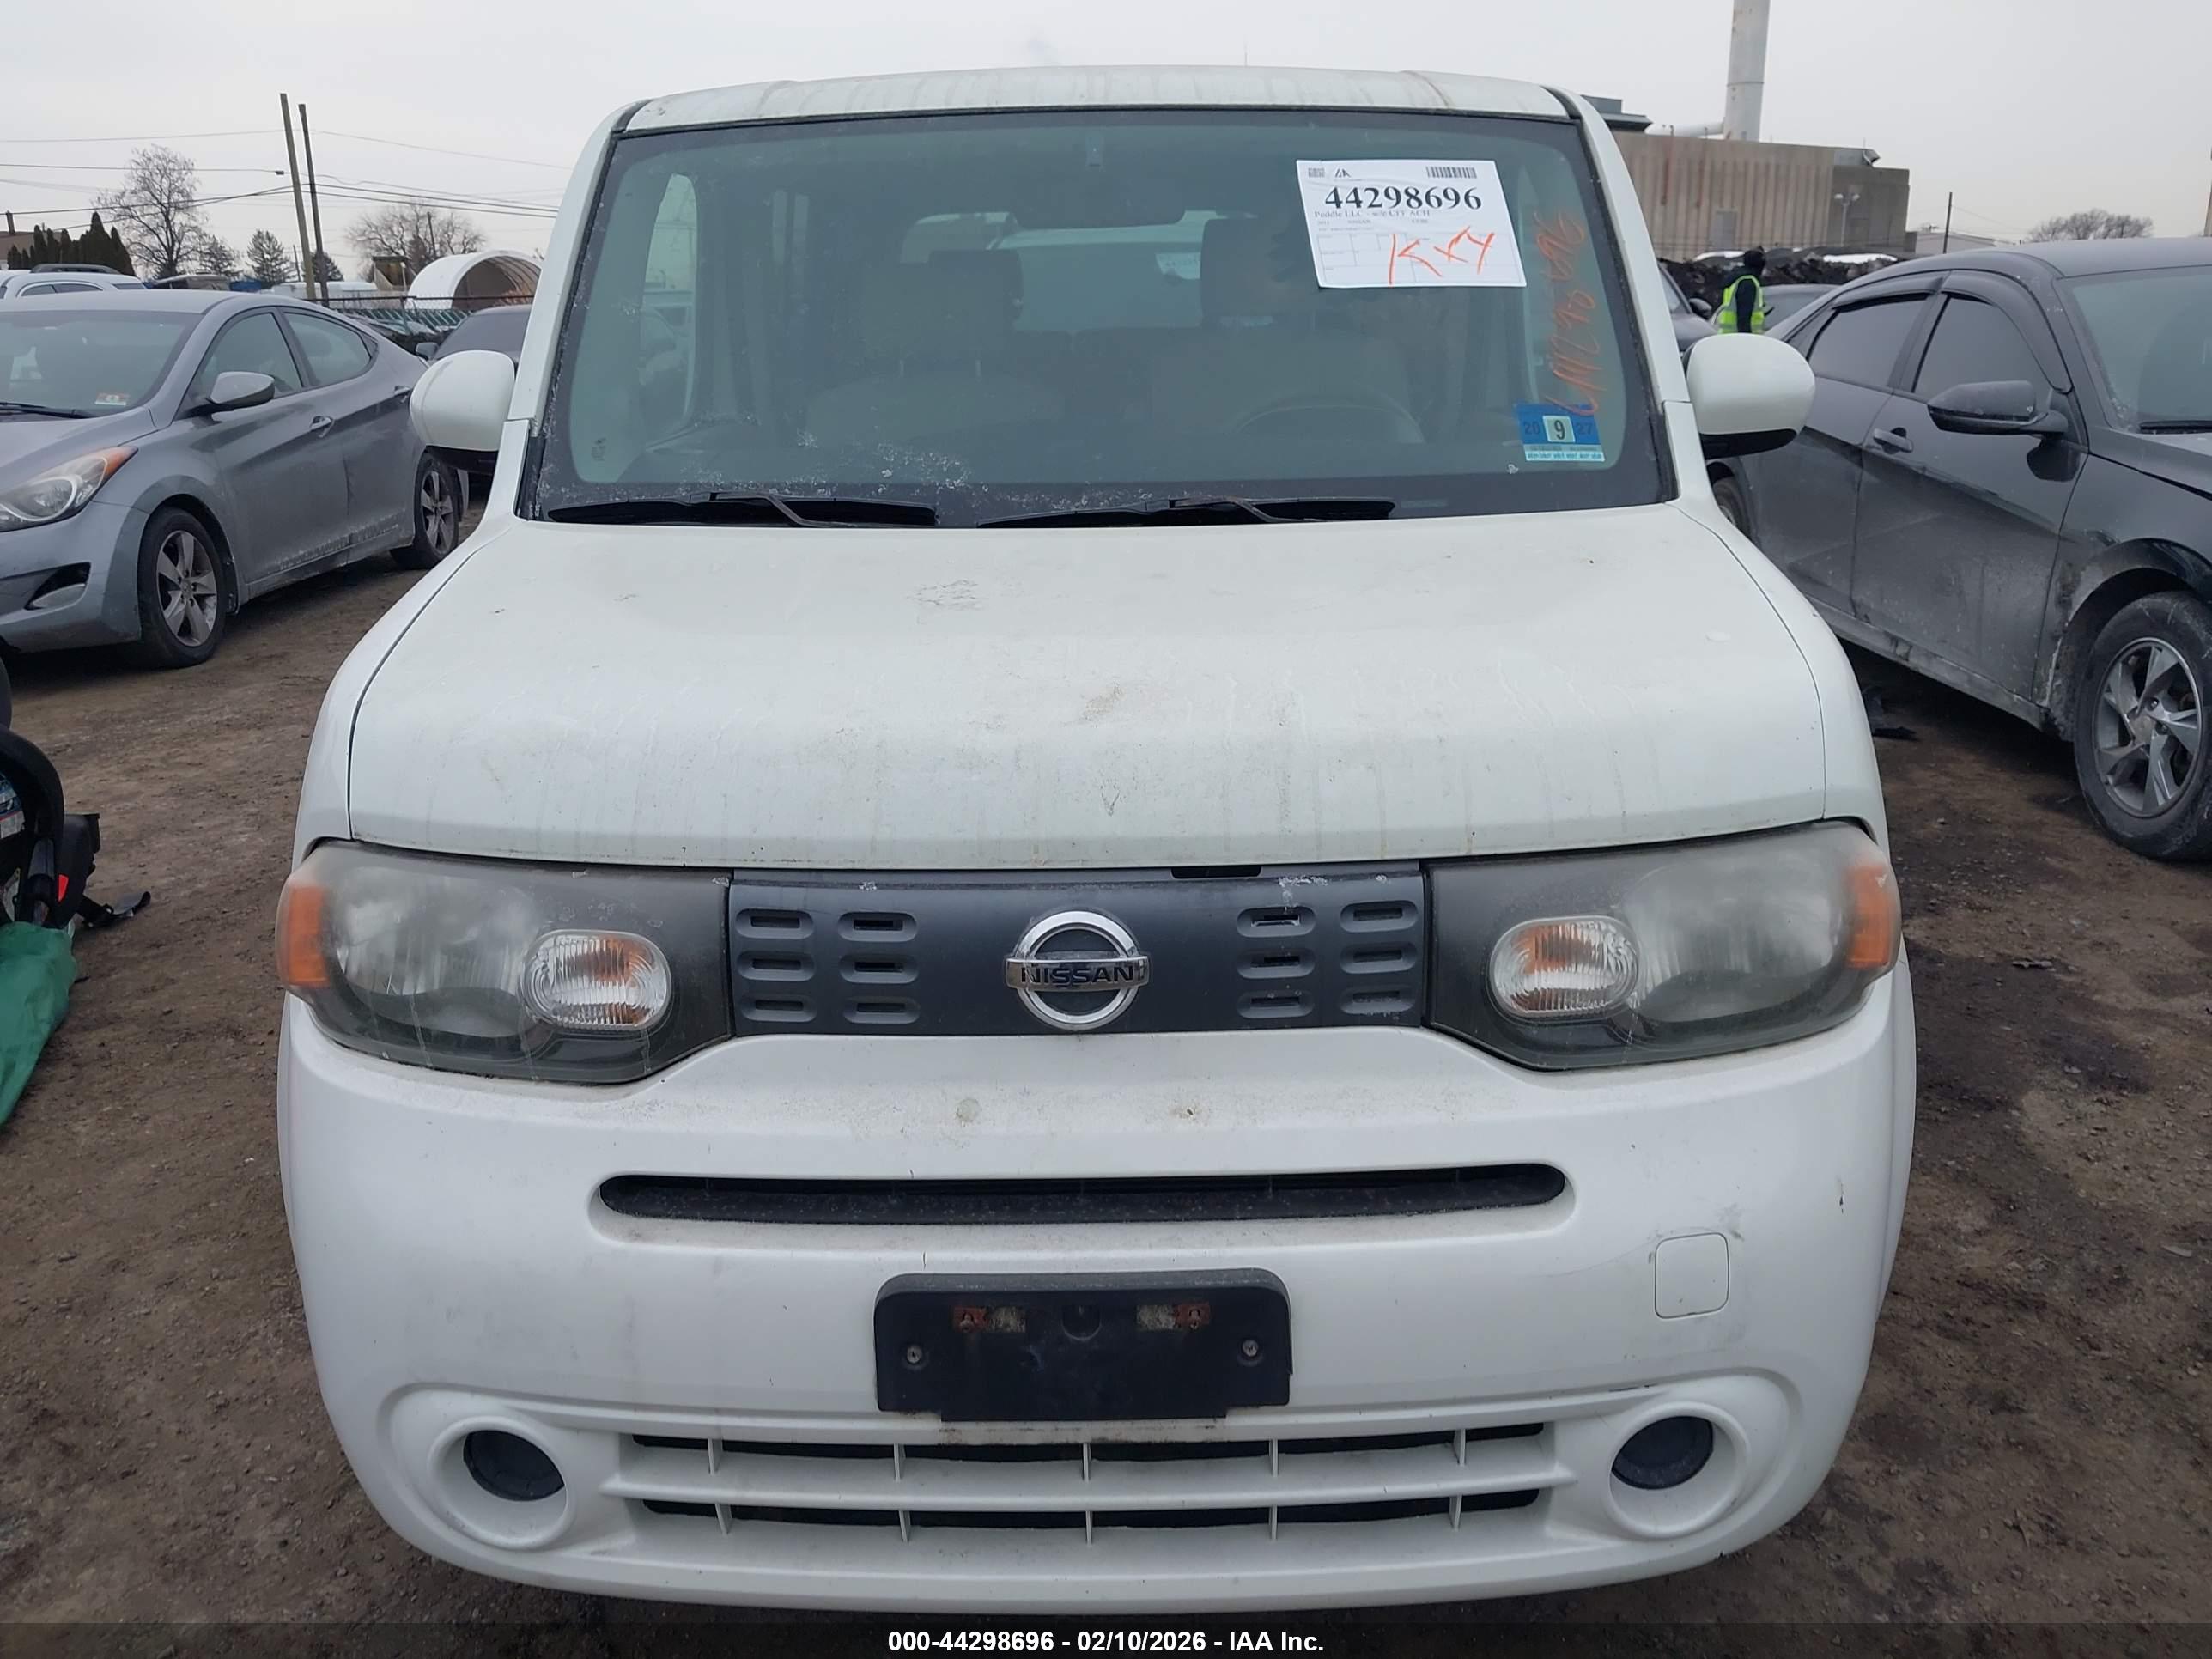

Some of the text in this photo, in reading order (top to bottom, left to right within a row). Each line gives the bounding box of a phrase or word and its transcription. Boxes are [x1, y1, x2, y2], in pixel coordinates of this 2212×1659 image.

[1324, 185, 1482, 210] 44298696
[1553, 419, 1565, 441] 9
[1021, 966, 1133, 985] NISSAN
